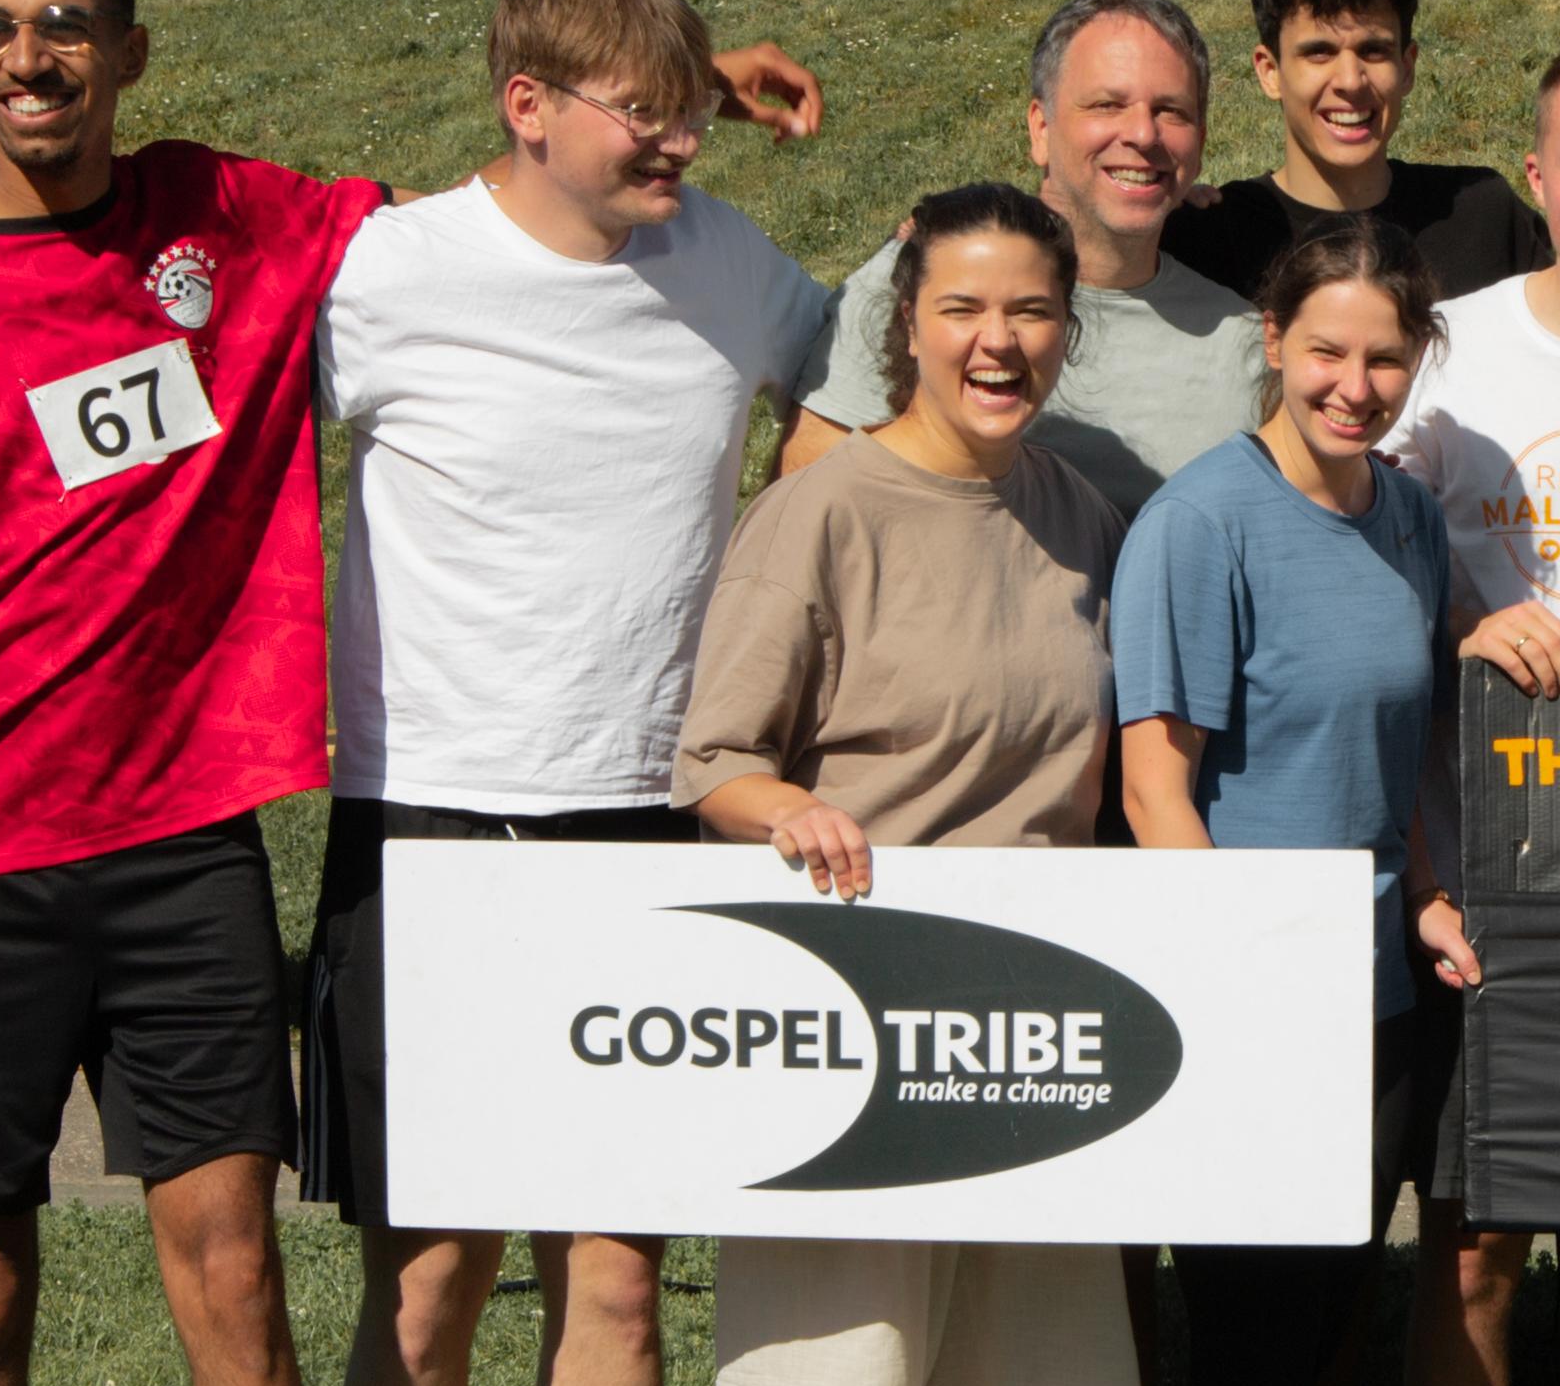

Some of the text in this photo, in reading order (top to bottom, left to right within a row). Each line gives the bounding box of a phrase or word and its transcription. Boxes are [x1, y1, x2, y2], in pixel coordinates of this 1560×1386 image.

[77, 366, 167, 458] 67
[568, 1004, 1104, 1075] GOSPEL TRIBE
[898, 1074, 1113, 1111] make a change
